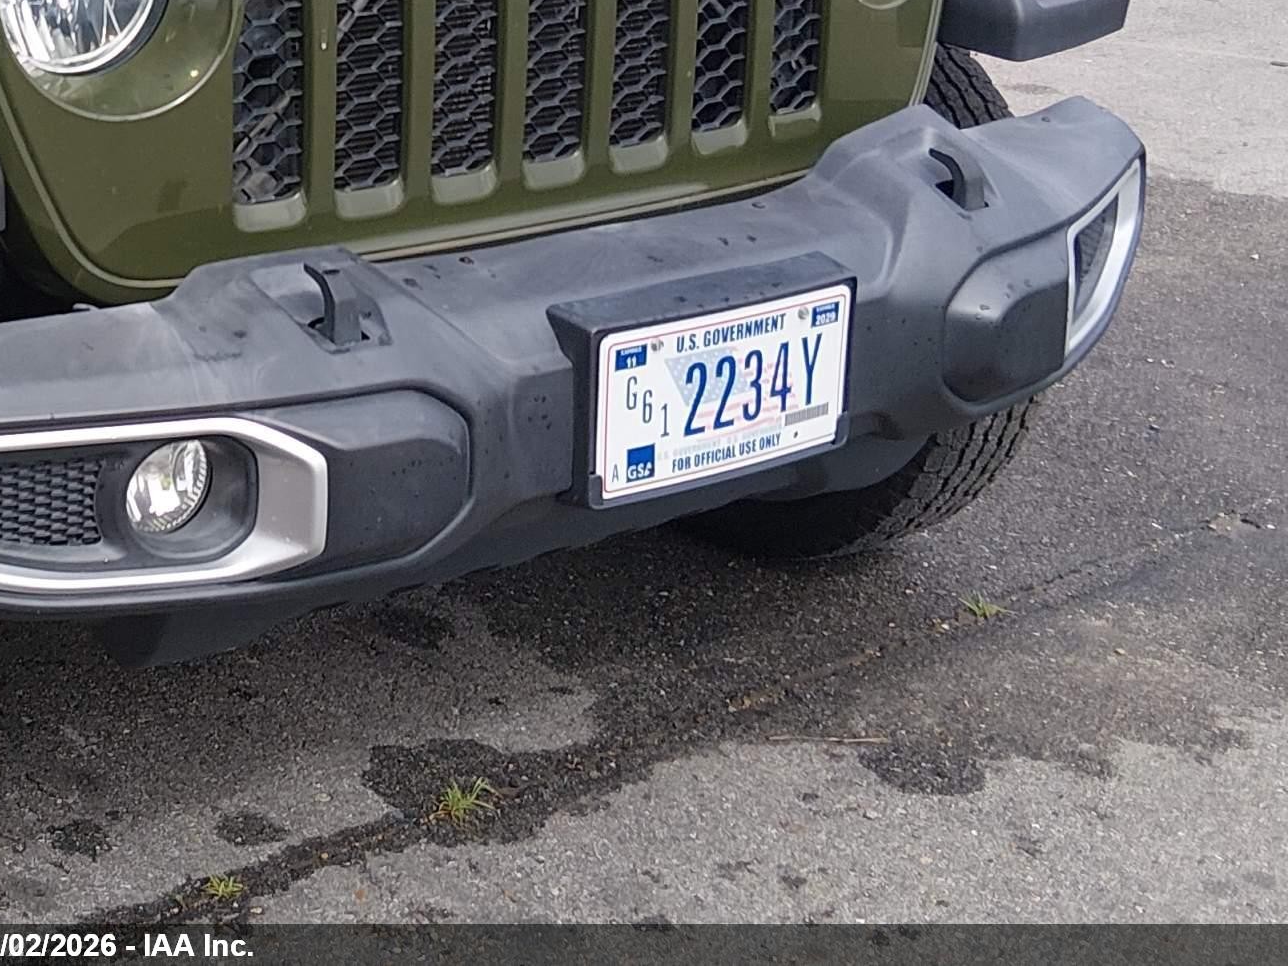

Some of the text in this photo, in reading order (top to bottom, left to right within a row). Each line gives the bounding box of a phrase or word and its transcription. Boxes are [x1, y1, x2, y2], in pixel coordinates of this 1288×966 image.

[703, 313, 786, 347] GOVERNMENT
[683, 333, 823, 437] 2234Y
[627, 462, 652, 479] GSA
[672, 456, 691, 473] FOR
[694, 443, 736, 467] OFFICIAL
[739, 438, 757, 456] USE
[759, 432, 781, 451] ONLY
